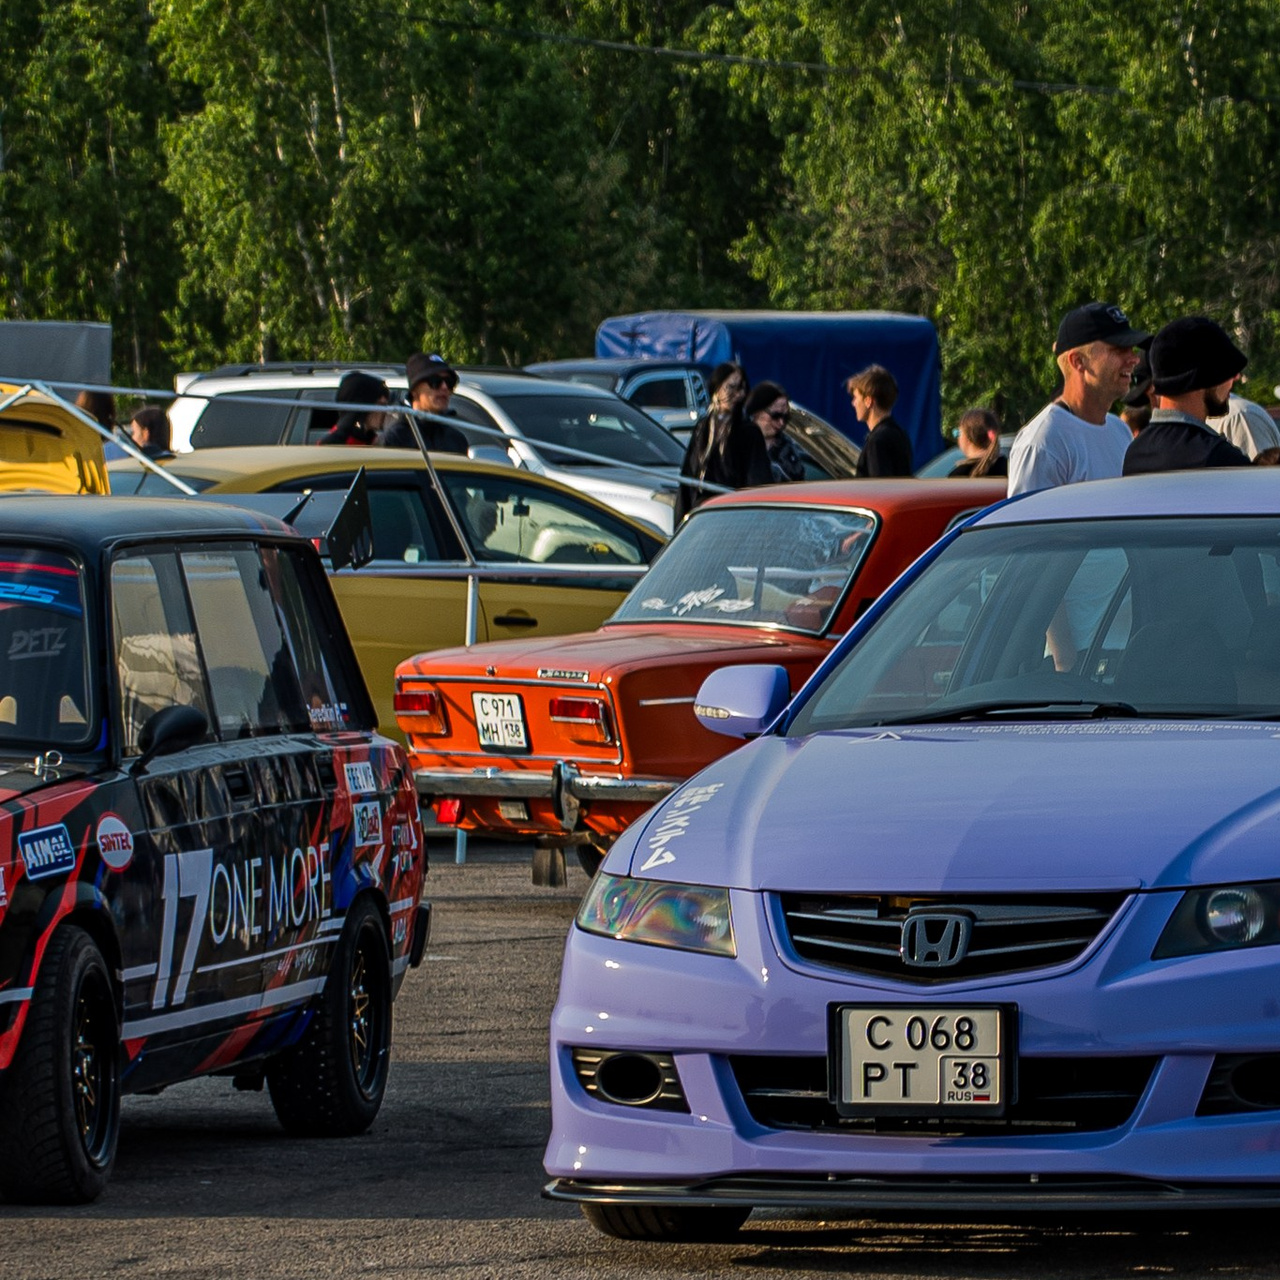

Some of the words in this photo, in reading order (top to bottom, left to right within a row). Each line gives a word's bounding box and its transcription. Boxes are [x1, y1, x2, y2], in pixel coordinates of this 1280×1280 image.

[491, 698, 514, 718] 971
[481, 722, 500, 742] MH
[504, 723, 522, 738] 138
[99, 832, 132, 853] SINTEC
[152, 847, 214, 1010] 17
[210, 857, 262, 945] ONE
[268, 842, 332, 932] MORE
[865, 1015, 892, 1051] C
[905, 1015, 975, 1051] 068
[952, 1061, 987, 1089] 38
[947, 1090, 972, 1102] RUS
